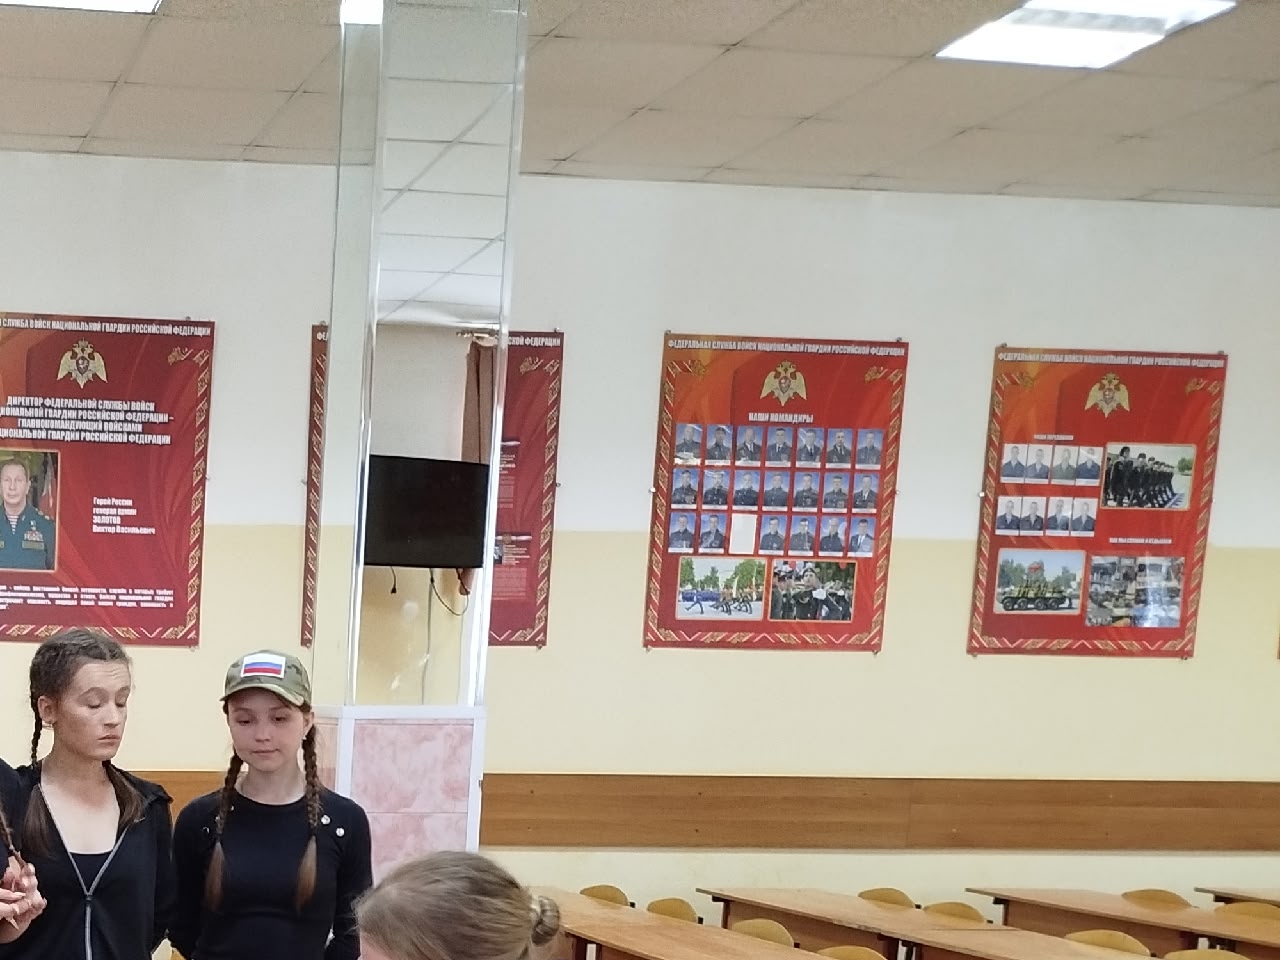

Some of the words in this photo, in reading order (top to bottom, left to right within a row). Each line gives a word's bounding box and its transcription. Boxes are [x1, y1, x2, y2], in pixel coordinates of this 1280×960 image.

[2, 318, 29, 328] СЛУЖБА
[29, 319, 51, 329] ВОЙСК
[51, 320, 100, 331] НАЦИОНАЛЬНОЙ
[101, 322, 130, 333] ГВАРДИИ
[131, 323, 173, 334] РОССИЙСКОЙ
[173, 326, 211, 337] ФЕДЕРАЦИИ
[524, 336, 561, 347] ФЕДЕРАЦИИ
[6, 395, 43, 407] ДИРЕКТОР
[44, 397, 97, 409] ФЕДЕРАЛЬНОЙ
[98, 400, 130, 411] СЛУЖБЫ
[130, 400, 155, 411] ВОЙСК
[44, 408, 77, 419] ГВАРДИИ
[77, 409, 125, 421] РОССИЙСКОЙ
[125, 412, 169, 424] ФЕДЕРАЦИИ
[769, 412, 814, 424] КОМАНДИРЫ
[17, 418, 102, 432] ГЛАВНОКОМАНДУЮЩИЙ
[103, 420, 143, 432] ВОЙСКАМИ
[47, 430, 80, 442] ГВАРДИИ
[80, 431, 128, 443] РОССИЙСКОЙ
[128, 433, 171, 445] ФЕДЕРАЦИИ
[92, 515, 121, 524] ЗОЛОТОВ
